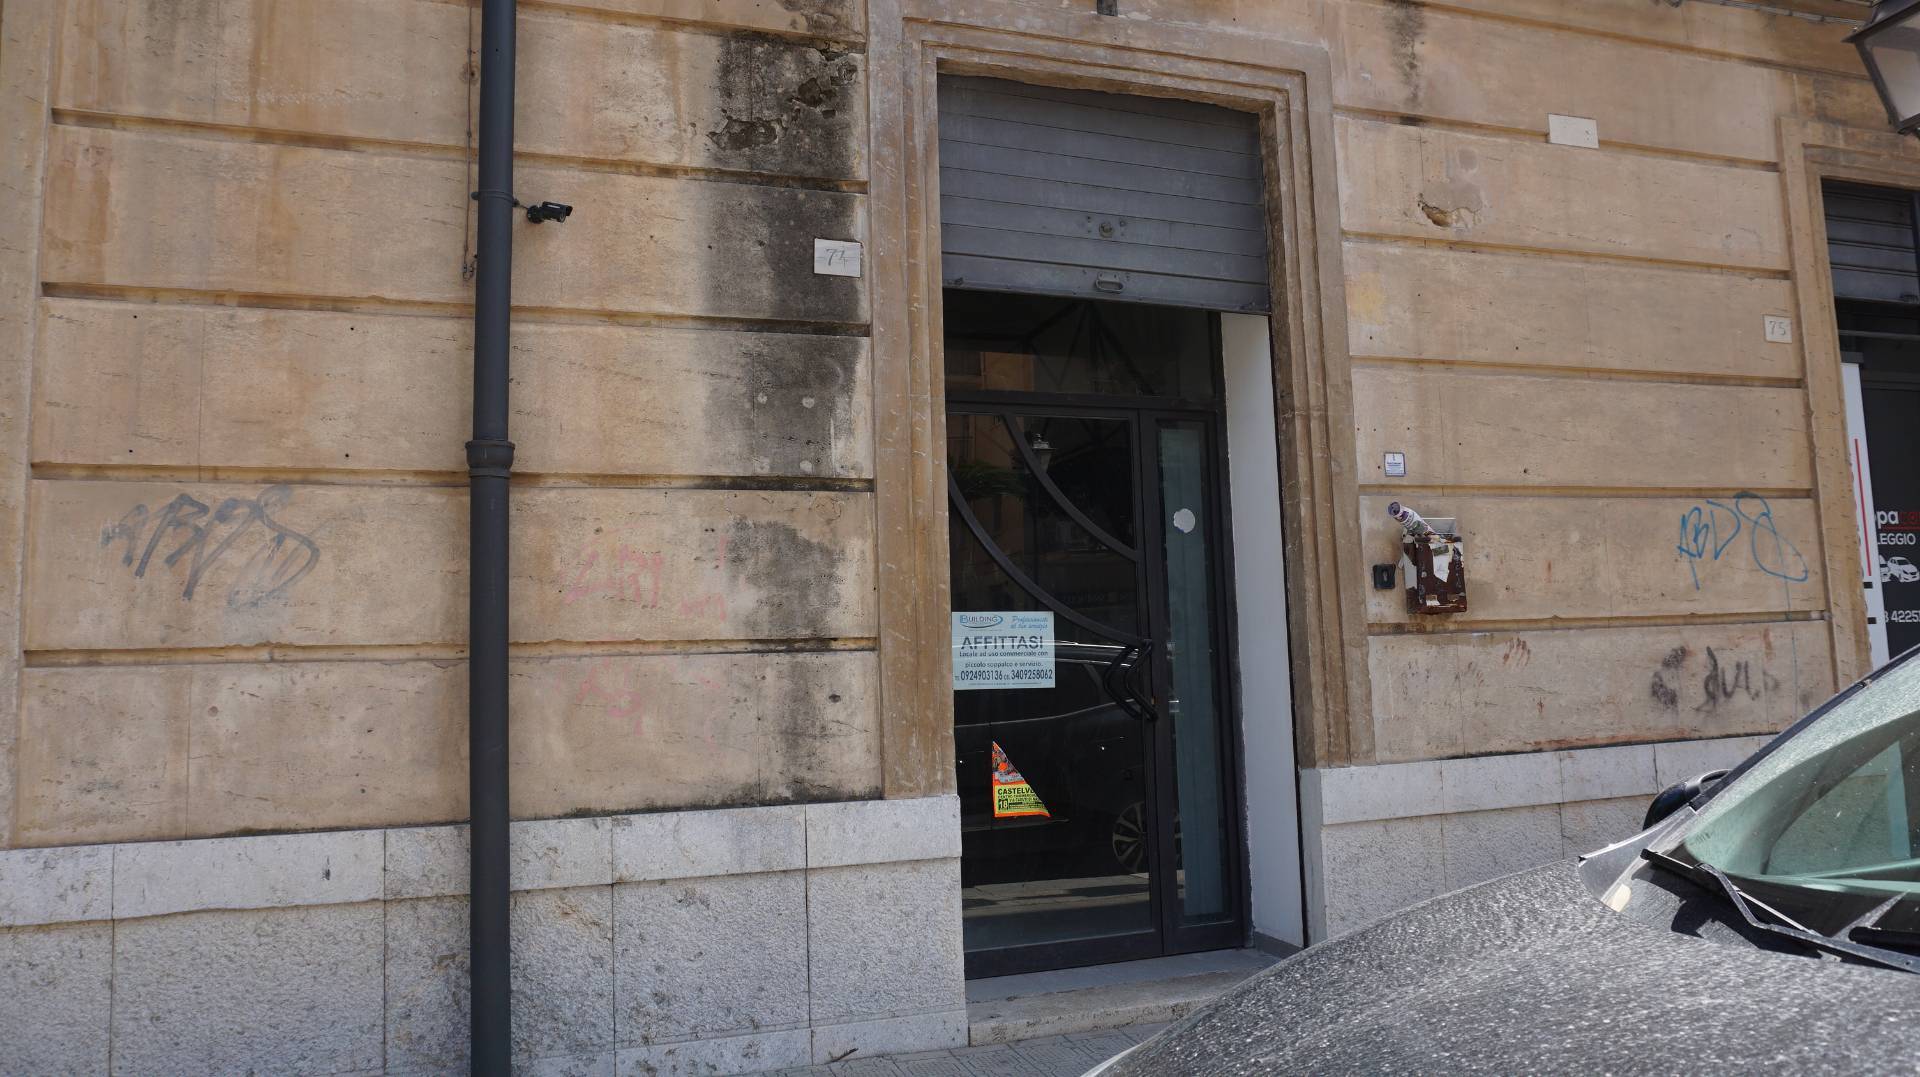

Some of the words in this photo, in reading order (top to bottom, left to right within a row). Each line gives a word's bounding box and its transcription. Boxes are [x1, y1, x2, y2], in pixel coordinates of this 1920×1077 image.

[826, 248, 855, 268] 74
[1891, 610, 1920, 622] 4225
[960, 635, 1043, 650] AFFITTASI
[960, 670, 1003, 681] 0924903136
[1011, 669, 1053, 680] 3409258062
